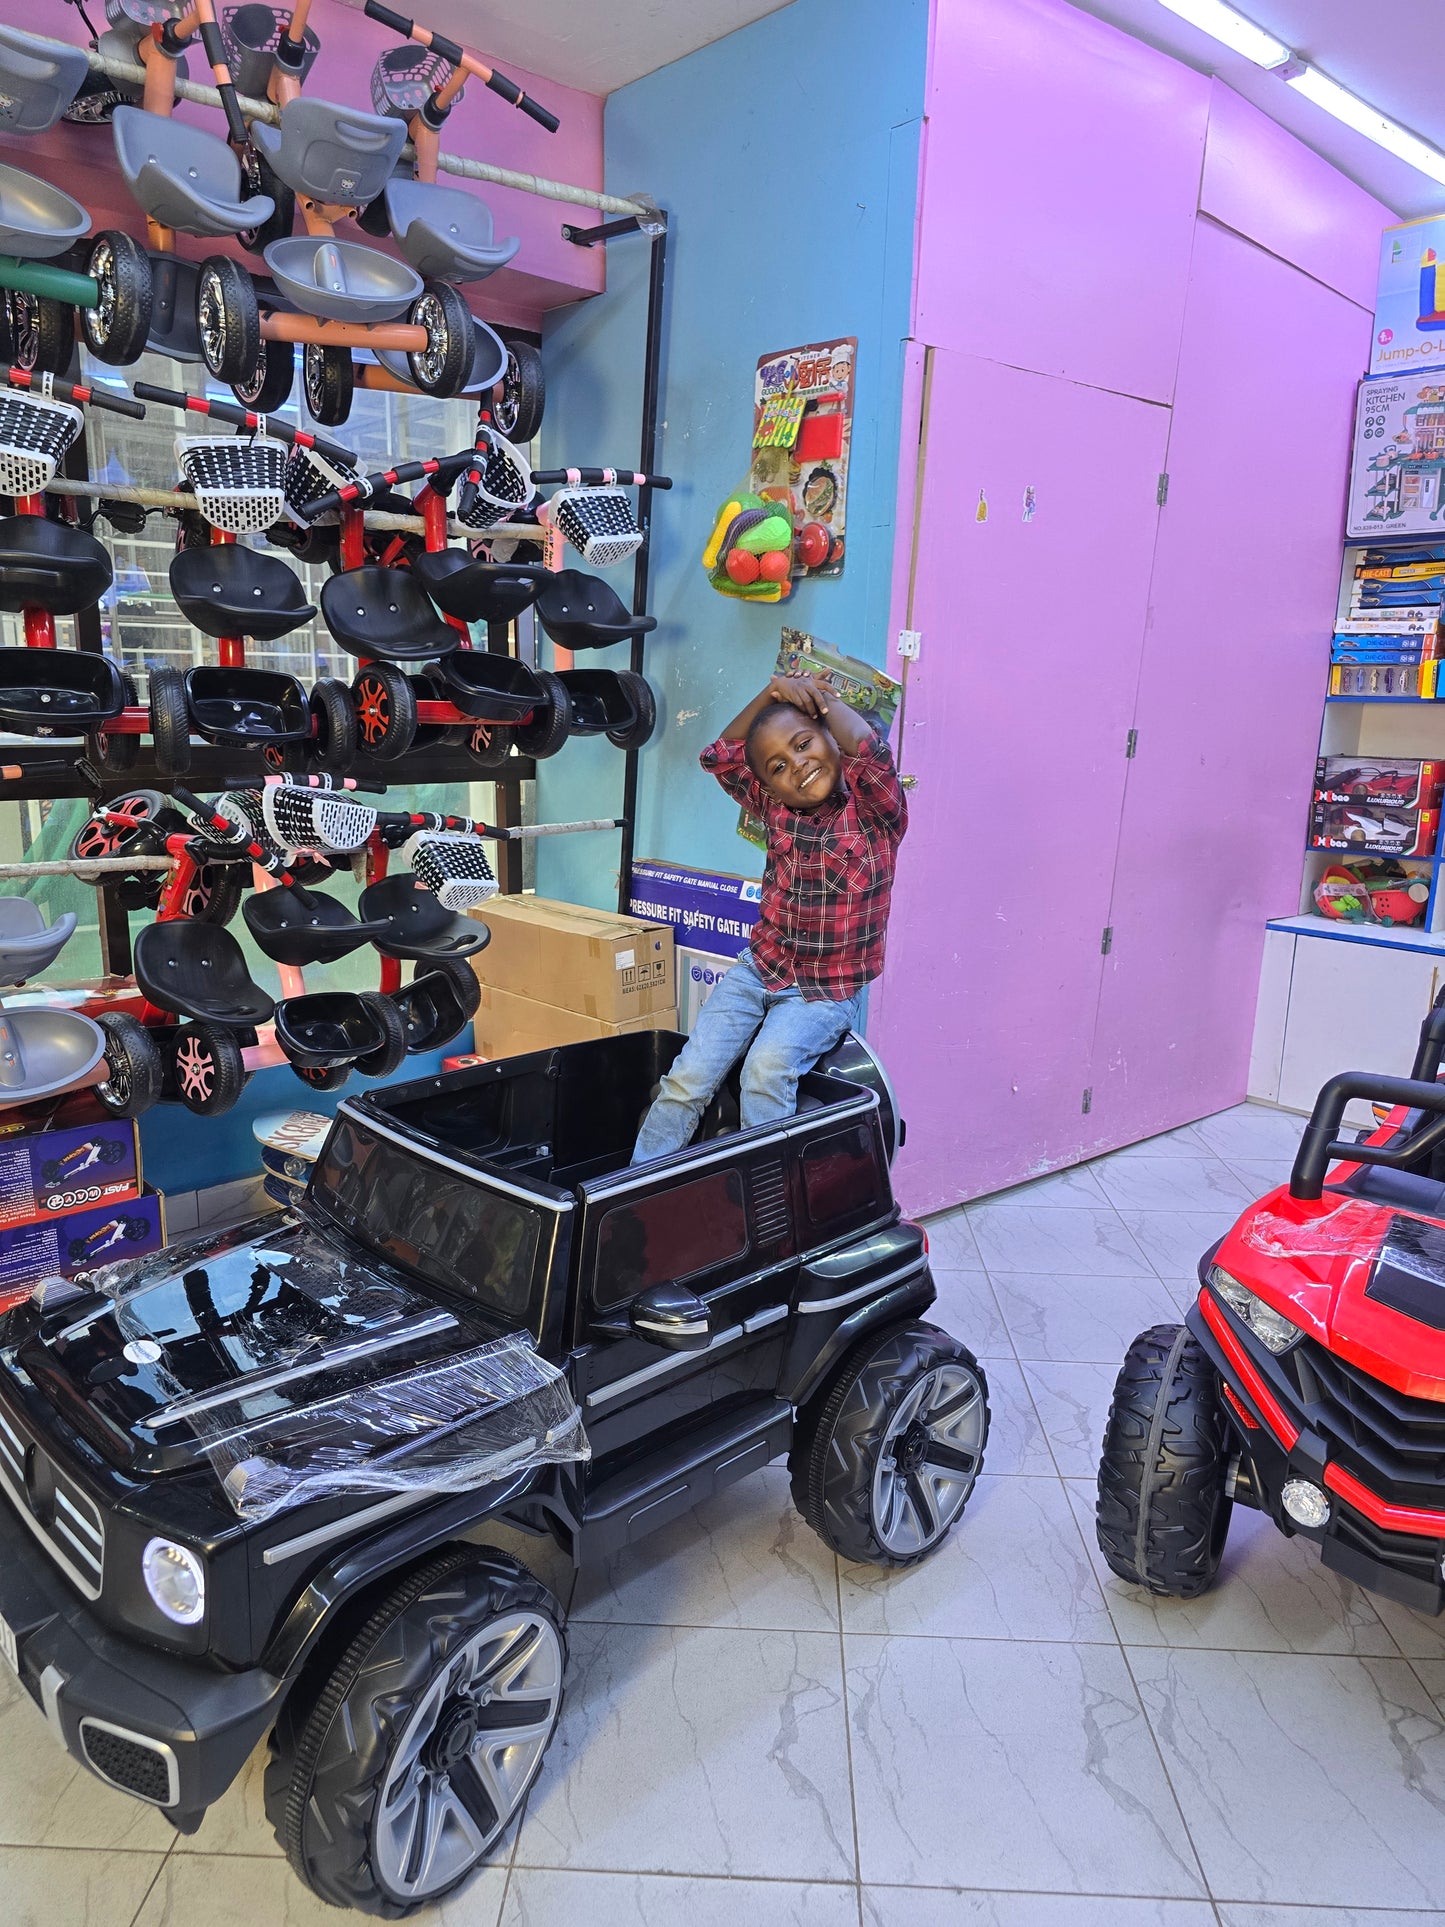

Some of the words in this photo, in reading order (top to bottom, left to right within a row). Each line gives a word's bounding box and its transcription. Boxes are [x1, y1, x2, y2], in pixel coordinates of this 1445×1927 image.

[1366, 385, 1399, 397] SPRAYING
[1365, 392, 1406, 406] KITCHEN
[1365, 403, 1390, 415] 95CM
[654, 871, 663, 879] FIT
[662, 872, 684, 882] SAFETY
[682, 876, 698, 885] GATE
[698, 879, 720, 890] MANUAL
[719, 883, 739, 894] CLOSE
[668, 907, 682, 924] FIT
[682, 909, 716, 931] SAFETY
[716, 917, 740, 937] GATE
[103, 1182, 130, 1196] FAST
